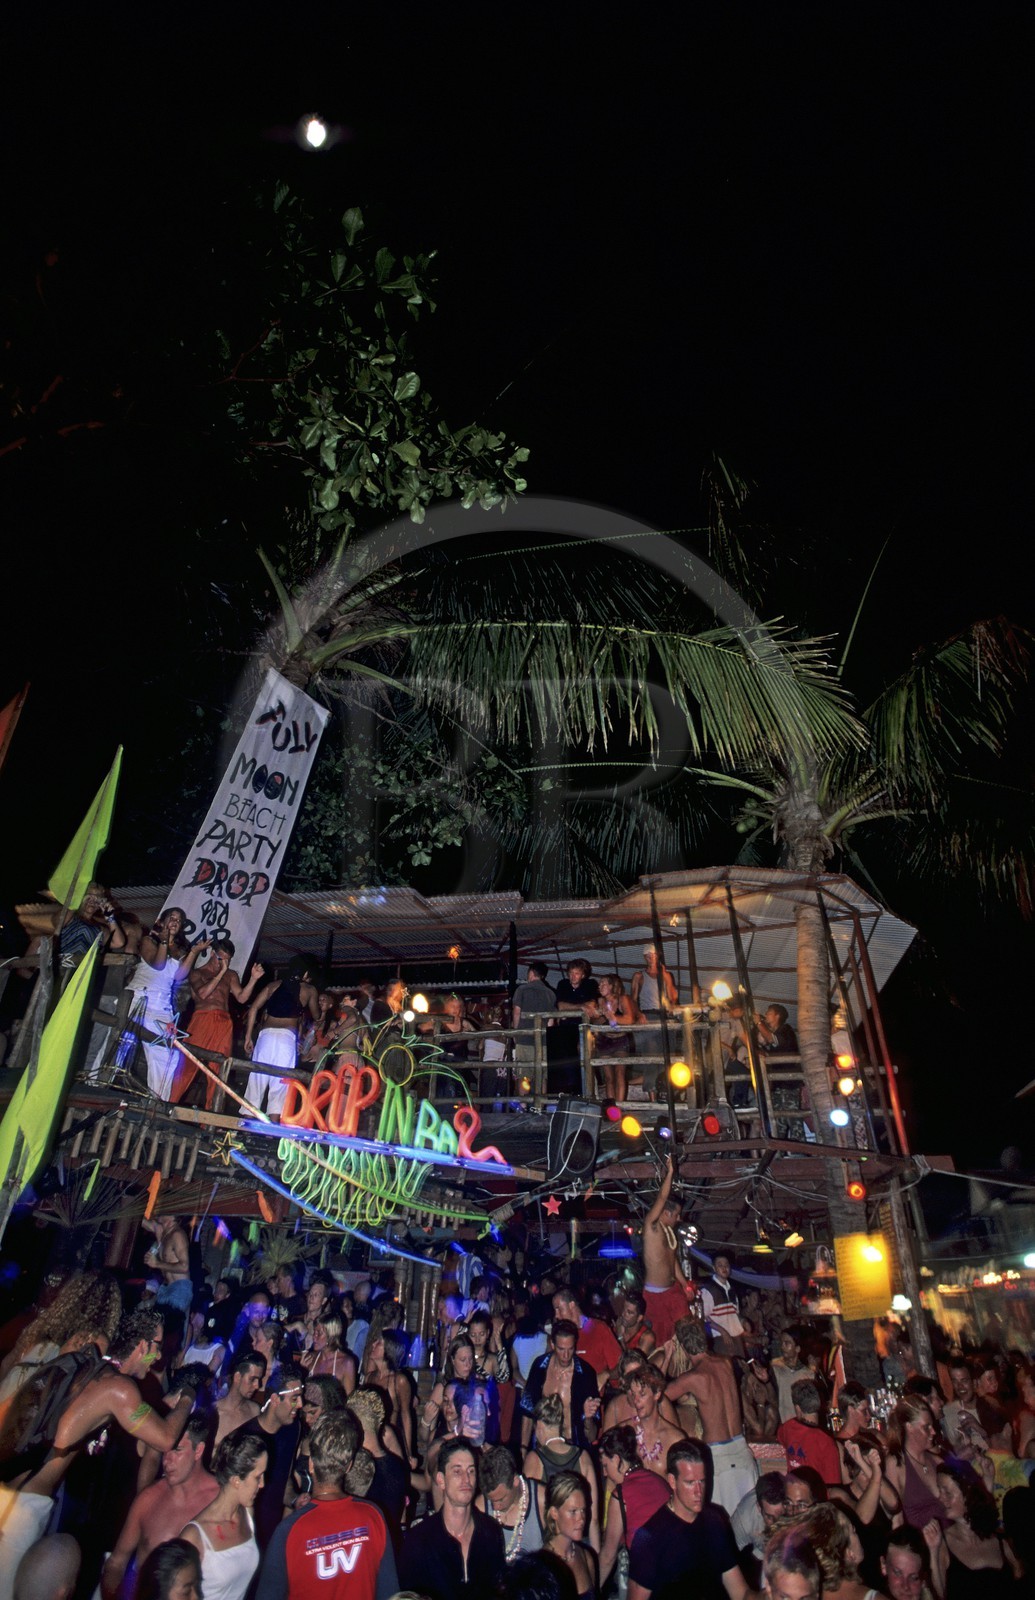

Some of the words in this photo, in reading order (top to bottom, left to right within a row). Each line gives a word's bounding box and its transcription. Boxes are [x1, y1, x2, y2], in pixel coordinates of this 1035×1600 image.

[230, 752, 299, 807] MOON
[223, 793, 287, 835] BEACH
[196, 819, 282, 869] PARTY
[182, 857, 270, 907] DROP
[280, 1062, 382, 1137] DROP
[377, 1078, 414, 1147] IN
[316, 1543, 363, 1580] UV
